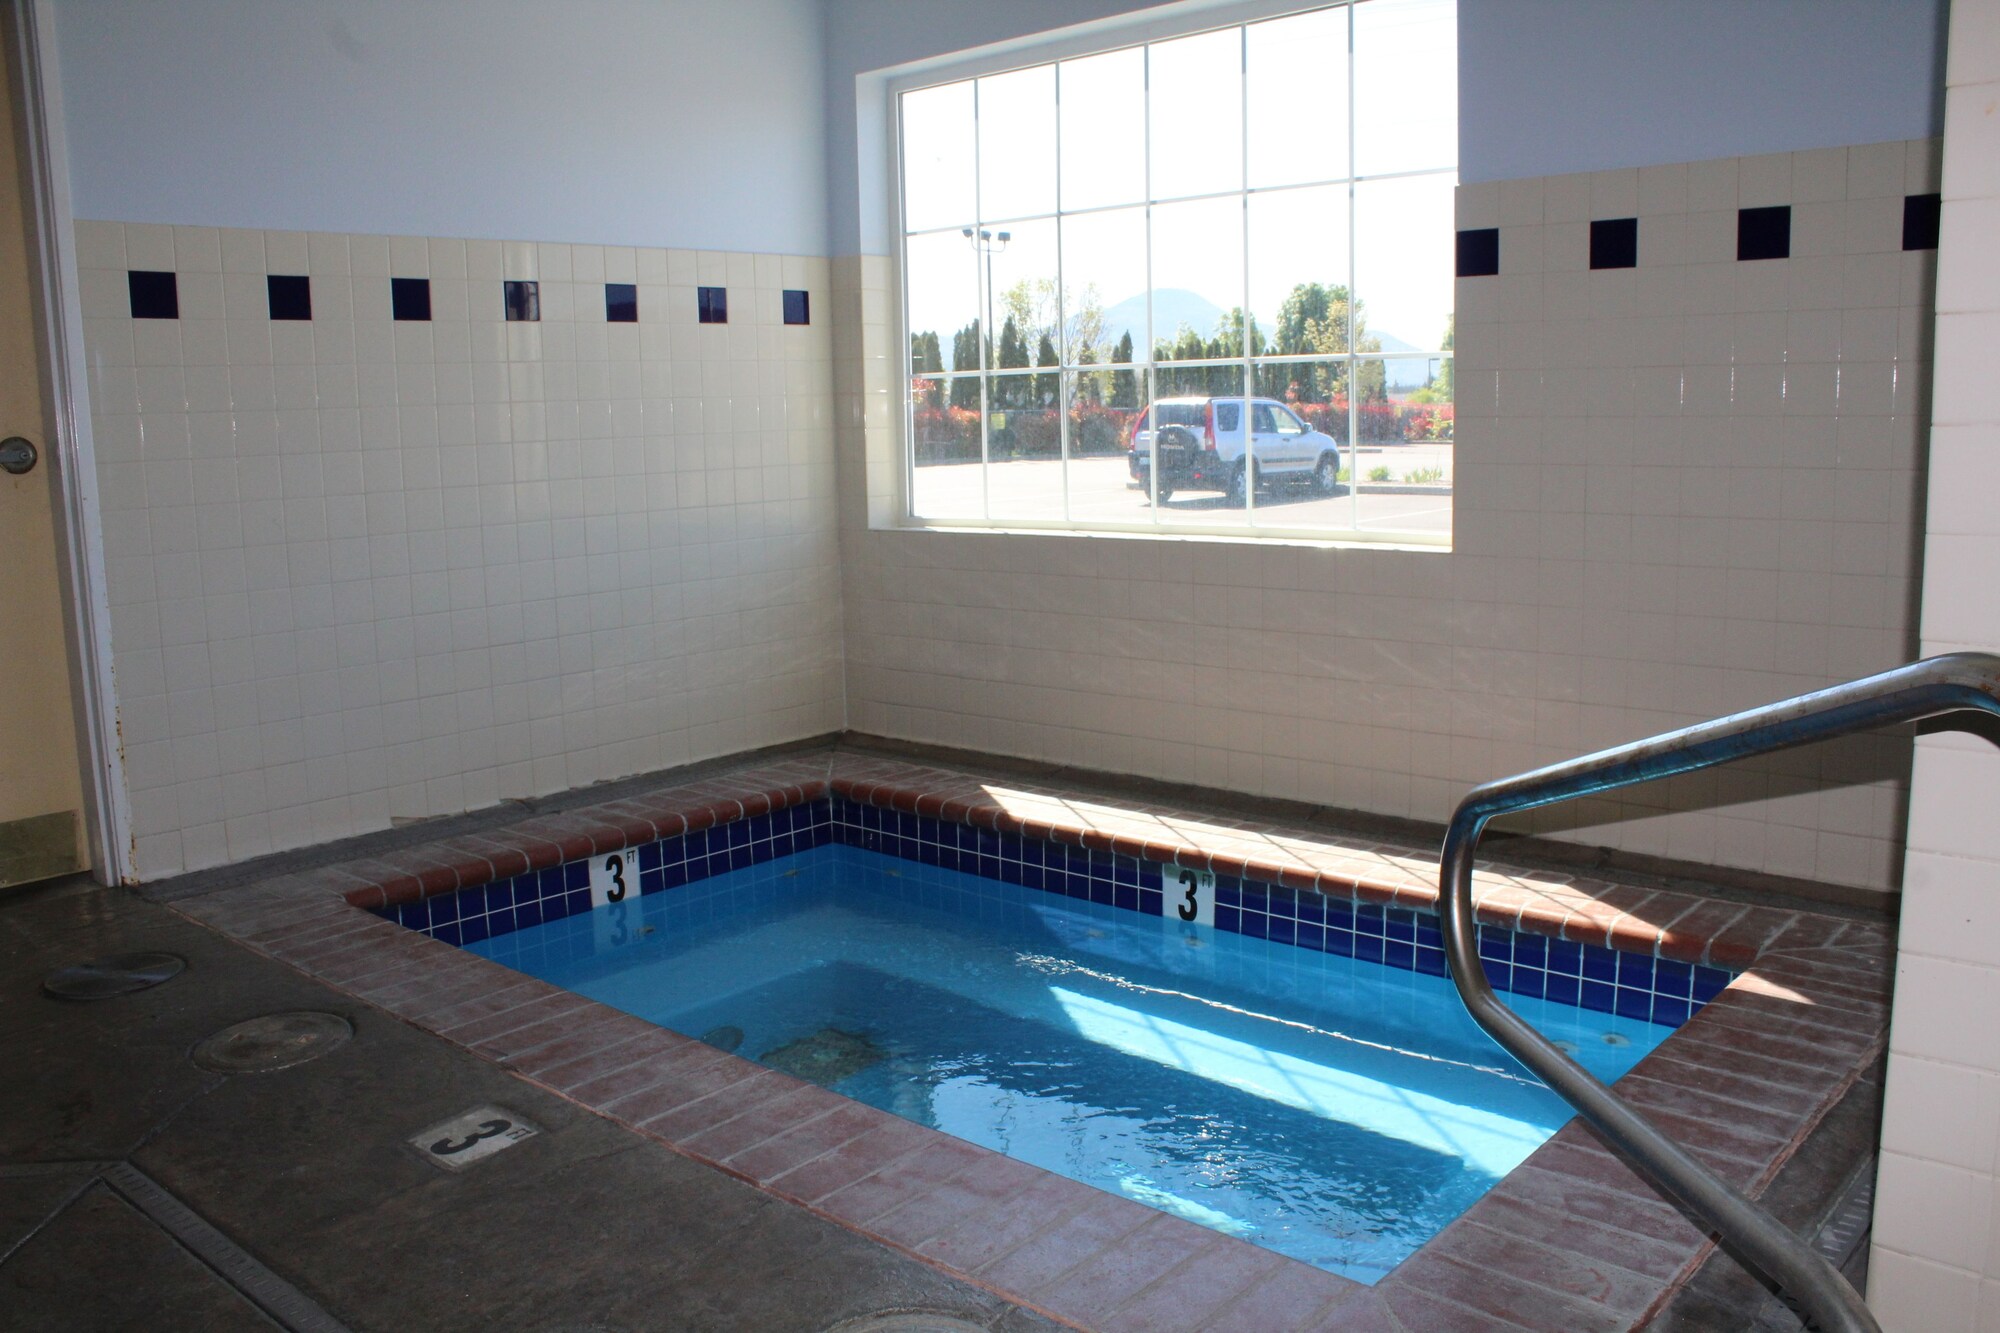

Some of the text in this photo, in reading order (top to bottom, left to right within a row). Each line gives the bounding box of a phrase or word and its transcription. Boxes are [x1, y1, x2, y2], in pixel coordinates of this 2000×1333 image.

[606, 850, 636, 903] 3 FT
[1178, 869, 1213, 922] 3 FT
[430, 1119, 532, 1155] 3 FT
